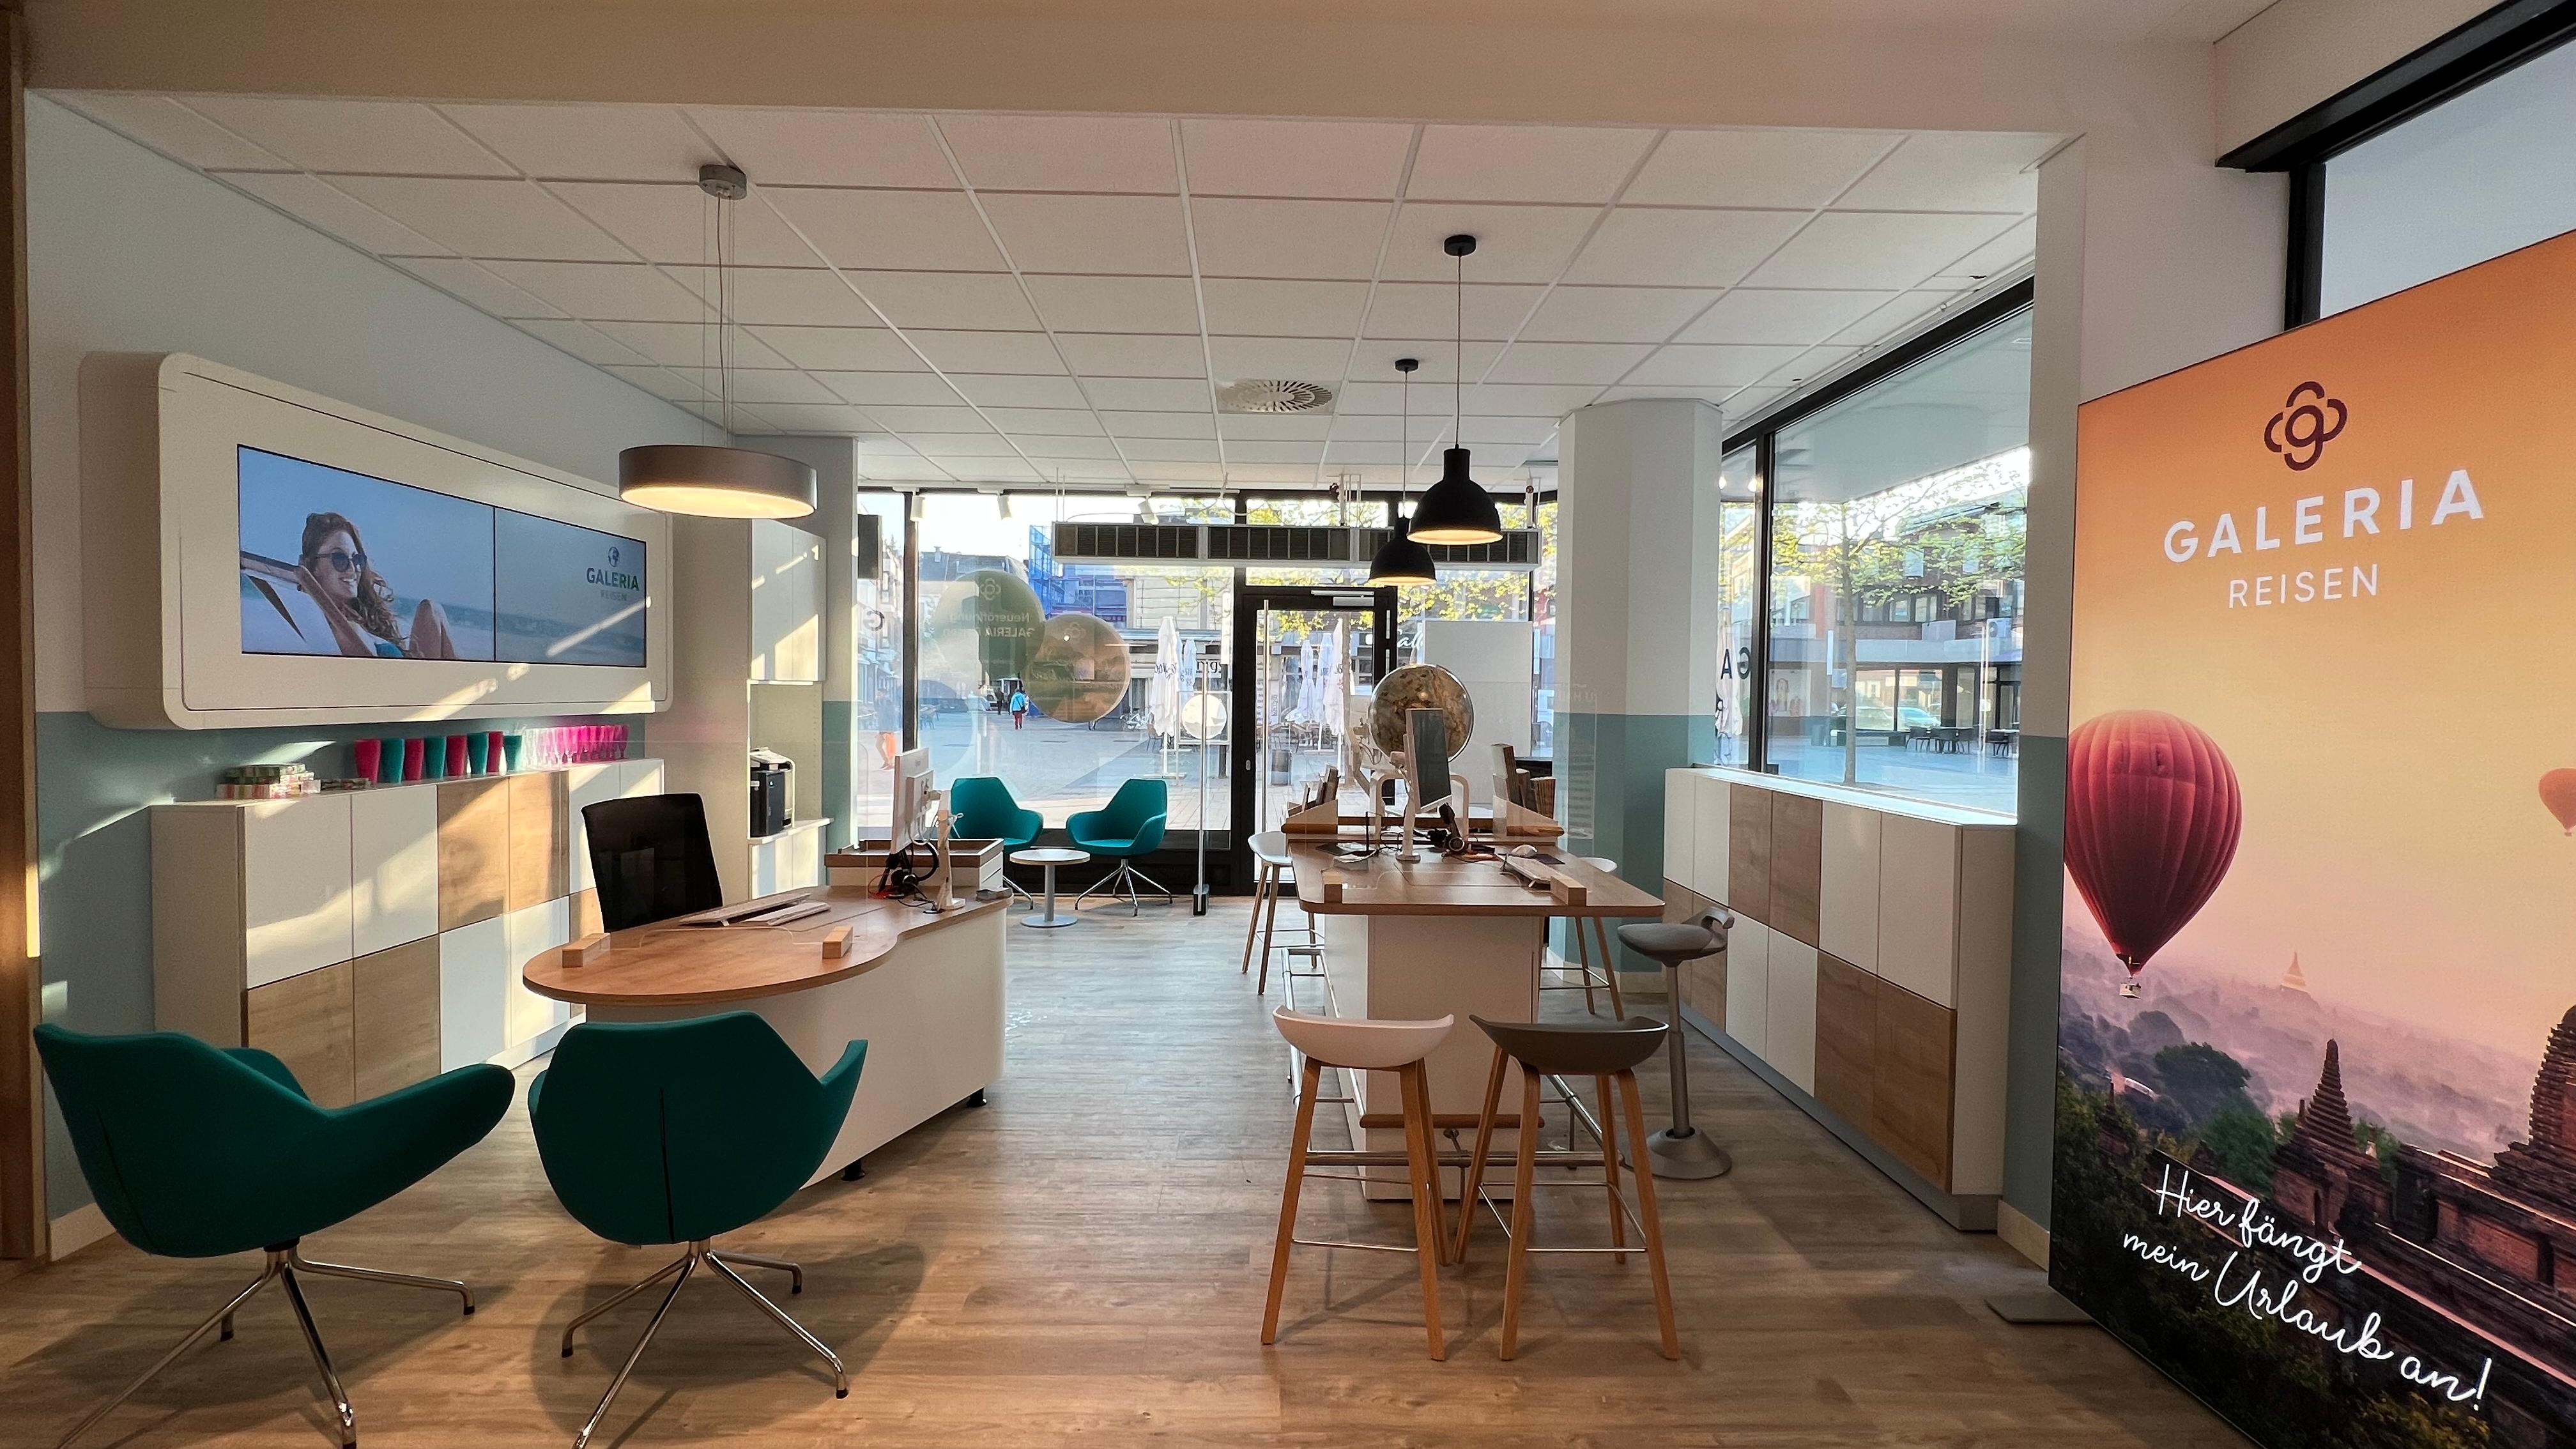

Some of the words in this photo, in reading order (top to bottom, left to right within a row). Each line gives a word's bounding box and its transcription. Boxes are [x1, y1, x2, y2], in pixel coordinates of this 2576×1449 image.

[2163, 469, 2484, 563] GALERIA
[586, 567, 640, 592] GALERIA
[601, 589, 627, 601] REISEN
[2228, 564, 2378, 609] REISEN
[2156, 1163, 2235, 1226] Hier
[2238, 1198, 2363, 1284] fängt
[2122, 1233, 2210, 1281] mein
[2214, 1250, 2394, 1361] Urlaub
[2400, 1357, 2492, 1411] an!
